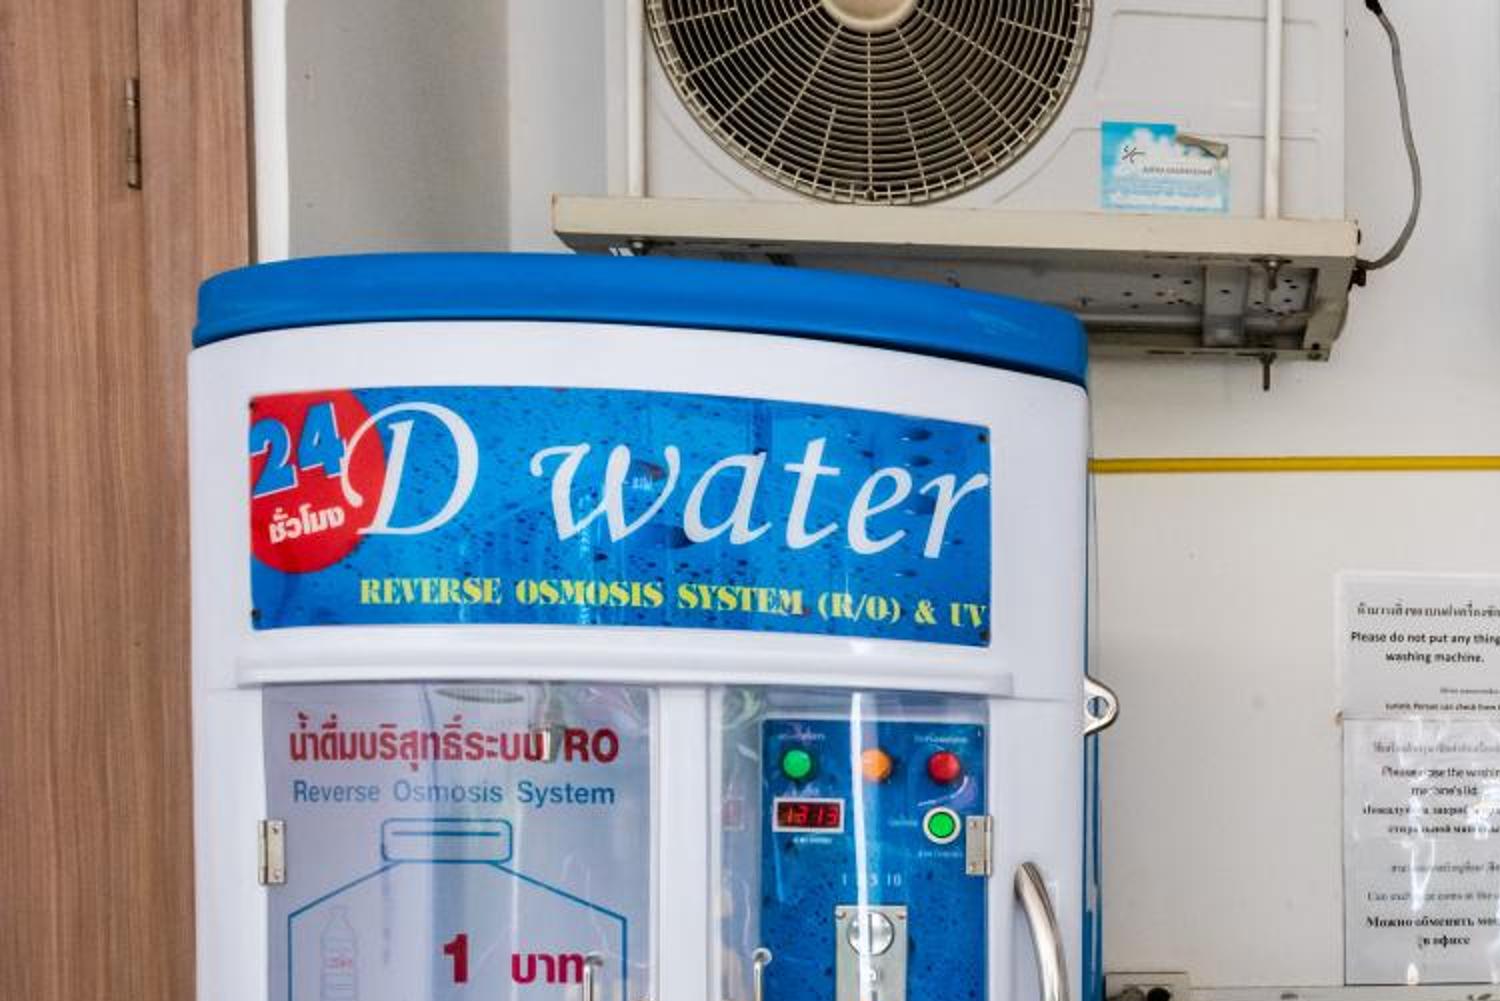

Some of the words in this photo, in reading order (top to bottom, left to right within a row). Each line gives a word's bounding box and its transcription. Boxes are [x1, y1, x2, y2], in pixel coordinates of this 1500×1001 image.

[251, 401, 346, 501] 24
[342, 402, 479, 537] D
[530, 437, 991, 559] water
[268, 503, 345, 545] ชั่วโมง
[359, 576, 503, 607] REVERSE
[515, 578, 664, 608] OSMOSIS
[677, 583, 804, 616] SYSTEM
[817, 593, 902, 625] (R/O)
[914, 600, 938, 625] &
[949, 601, 988, 632] UV
[1351, 631, 1387, 643] Please
[1389, 631, 1404, 643] do
[1407, 633, 1426, 643] not
[1429, 633, 1448, 646] put
[1451, 634, 1471, 646] any
[1385, 652, 1431, 665] washing
[1434, 652, 1485, 663] machine.
[563, 728, 620, 763] RO
[1447, 766, 1465, 778] the
[292, 779, 382, 804] Reverse
[393, 779, 504, 804] Osmosis
[517, 780, 616, 809] System
[1366, 916, 1413, 928] Можно
[443, 933, 469, 984] 1
[511, 953, 586, 985] บาท
